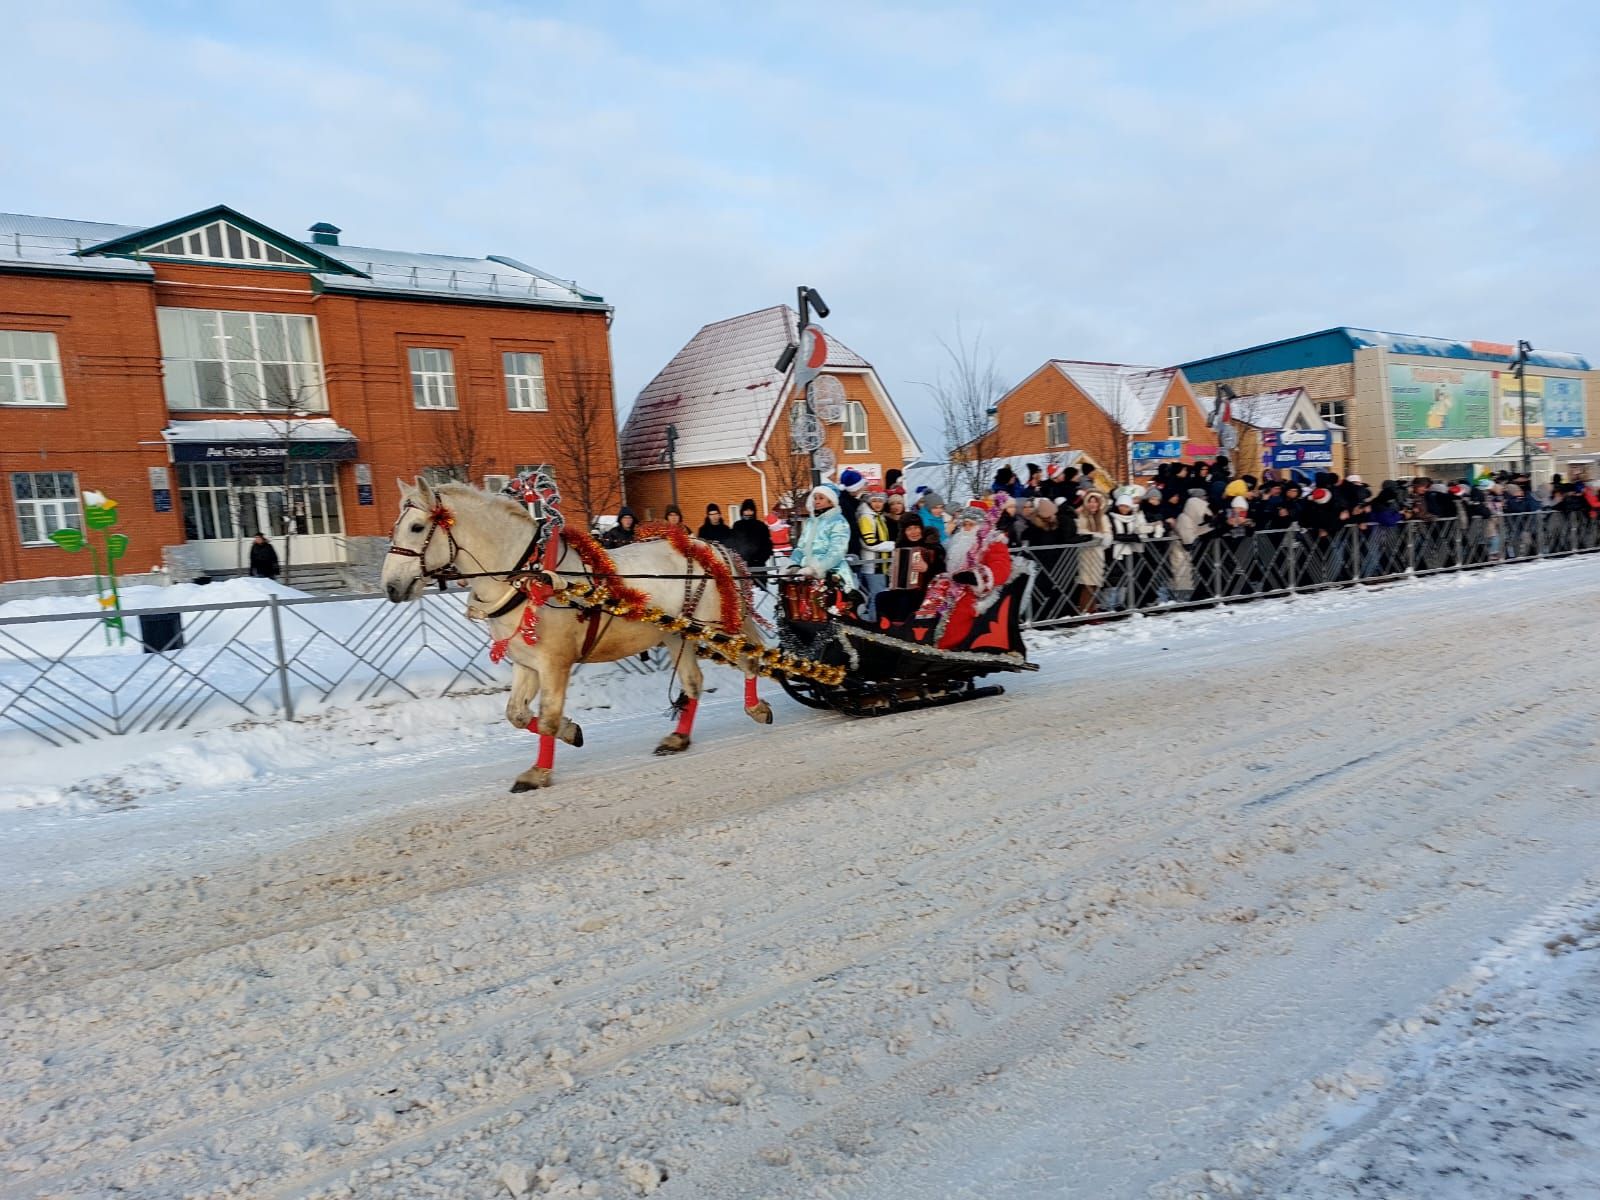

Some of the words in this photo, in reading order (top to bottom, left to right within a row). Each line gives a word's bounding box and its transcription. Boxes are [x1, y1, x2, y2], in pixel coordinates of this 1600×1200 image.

[206, 447, 224, 457] Ак
[225, 446, 257, 458] Барс
[258, 446, 289, 456] Банк
